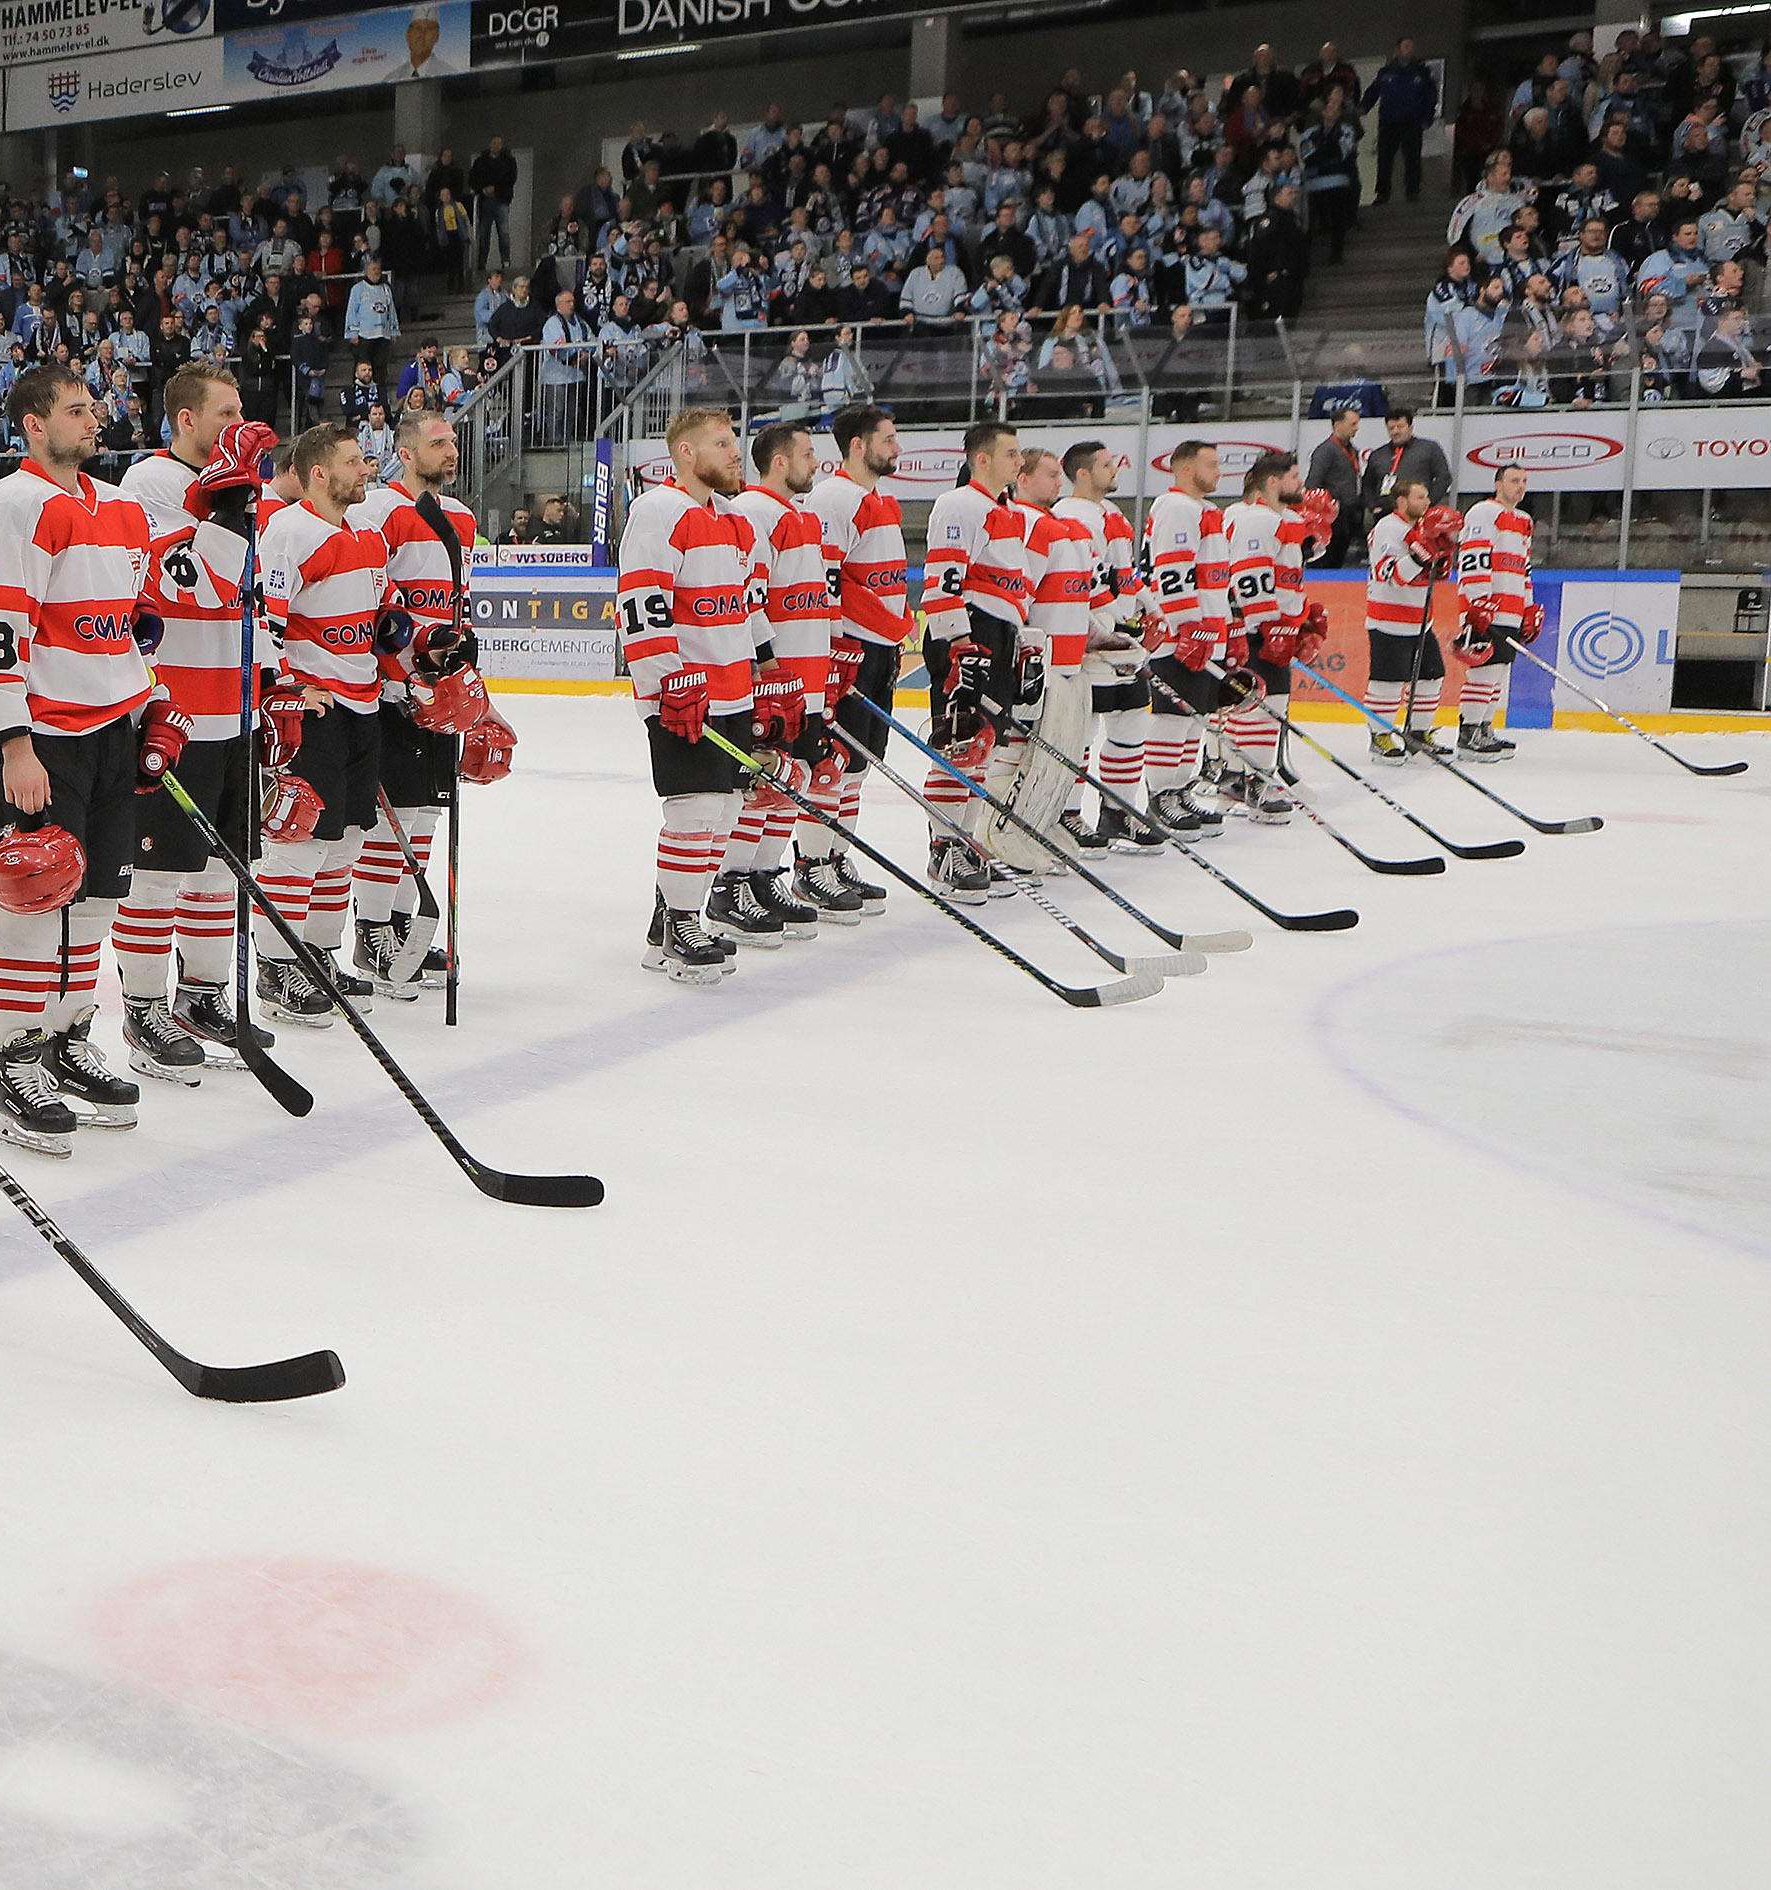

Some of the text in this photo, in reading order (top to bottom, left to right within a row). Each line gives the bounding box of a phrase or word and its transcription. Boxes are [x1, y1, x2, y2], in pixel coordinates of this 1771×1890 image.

[42, 29, 56, 41] 50
[59, 27, 74, 39] 73
[76, 23, 90, 36] 85
[488, 5, 559, 36] DCGR
[2, 35, 110, 61] www.hammelev-el.dk
[88, 71, 202, 99] Haderslev
[1692, 439, 1771, 457] TOYO
[516, 552, 589, 564] VVS SØBERG
[1461, 552, 1492, 571] 20
[1159, 567, 1198, 596] 24
[1237, 573, 1276, 598] 90
[475, 599, 616, 621] ONTIGA
[622, 594, 677, 635] 19
